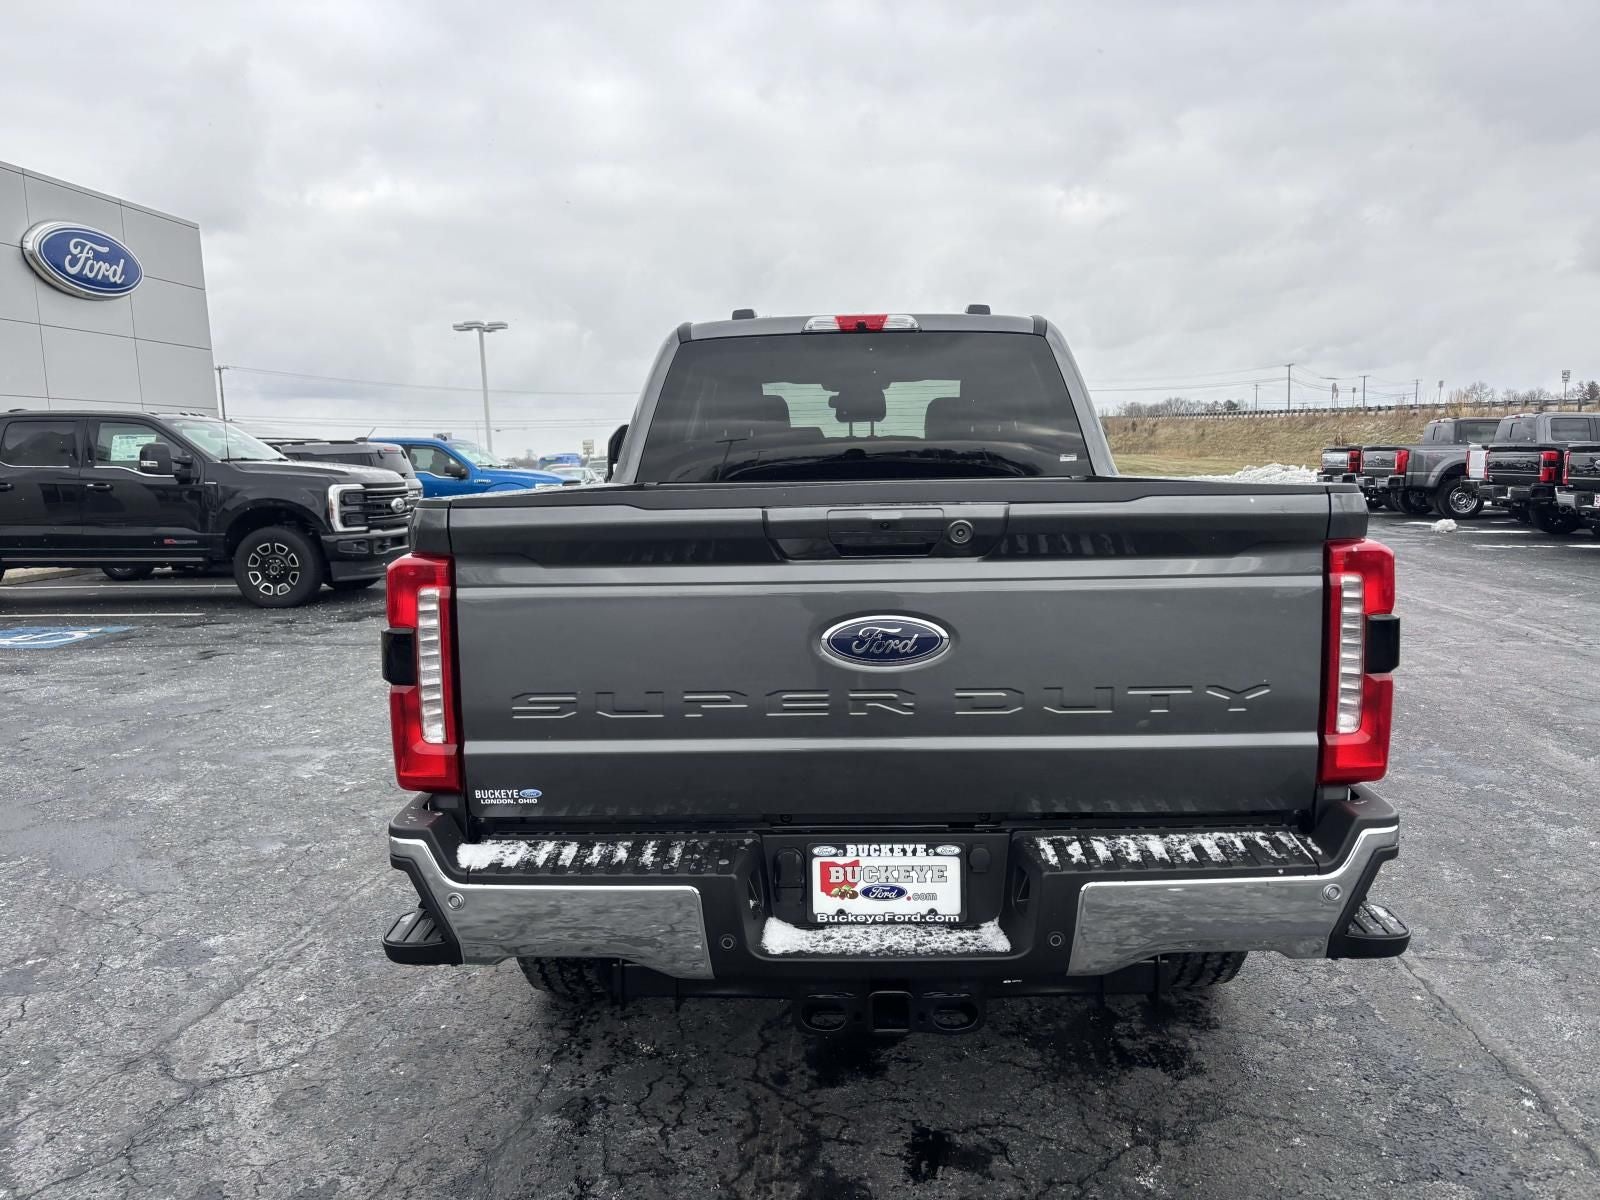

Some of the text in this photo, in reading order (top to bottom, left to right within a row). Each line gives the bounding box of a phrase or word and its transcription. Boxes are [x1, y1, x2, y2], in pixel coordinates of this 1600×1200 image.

[64, 238, 125, 284] Ford
[851, 626, 919, 654] Ford
[511, 683, 1271, 719] SUPER DUTY
[474, 789, 519, 799] BUCKEYE
[845, 844, 927, 857] BUCKEYE
[828, 865, 948, 883] BUCKEYE
[868, 886, 898, 899] Ford
[816, 912, 960, 923] BuckeyeFord.com
